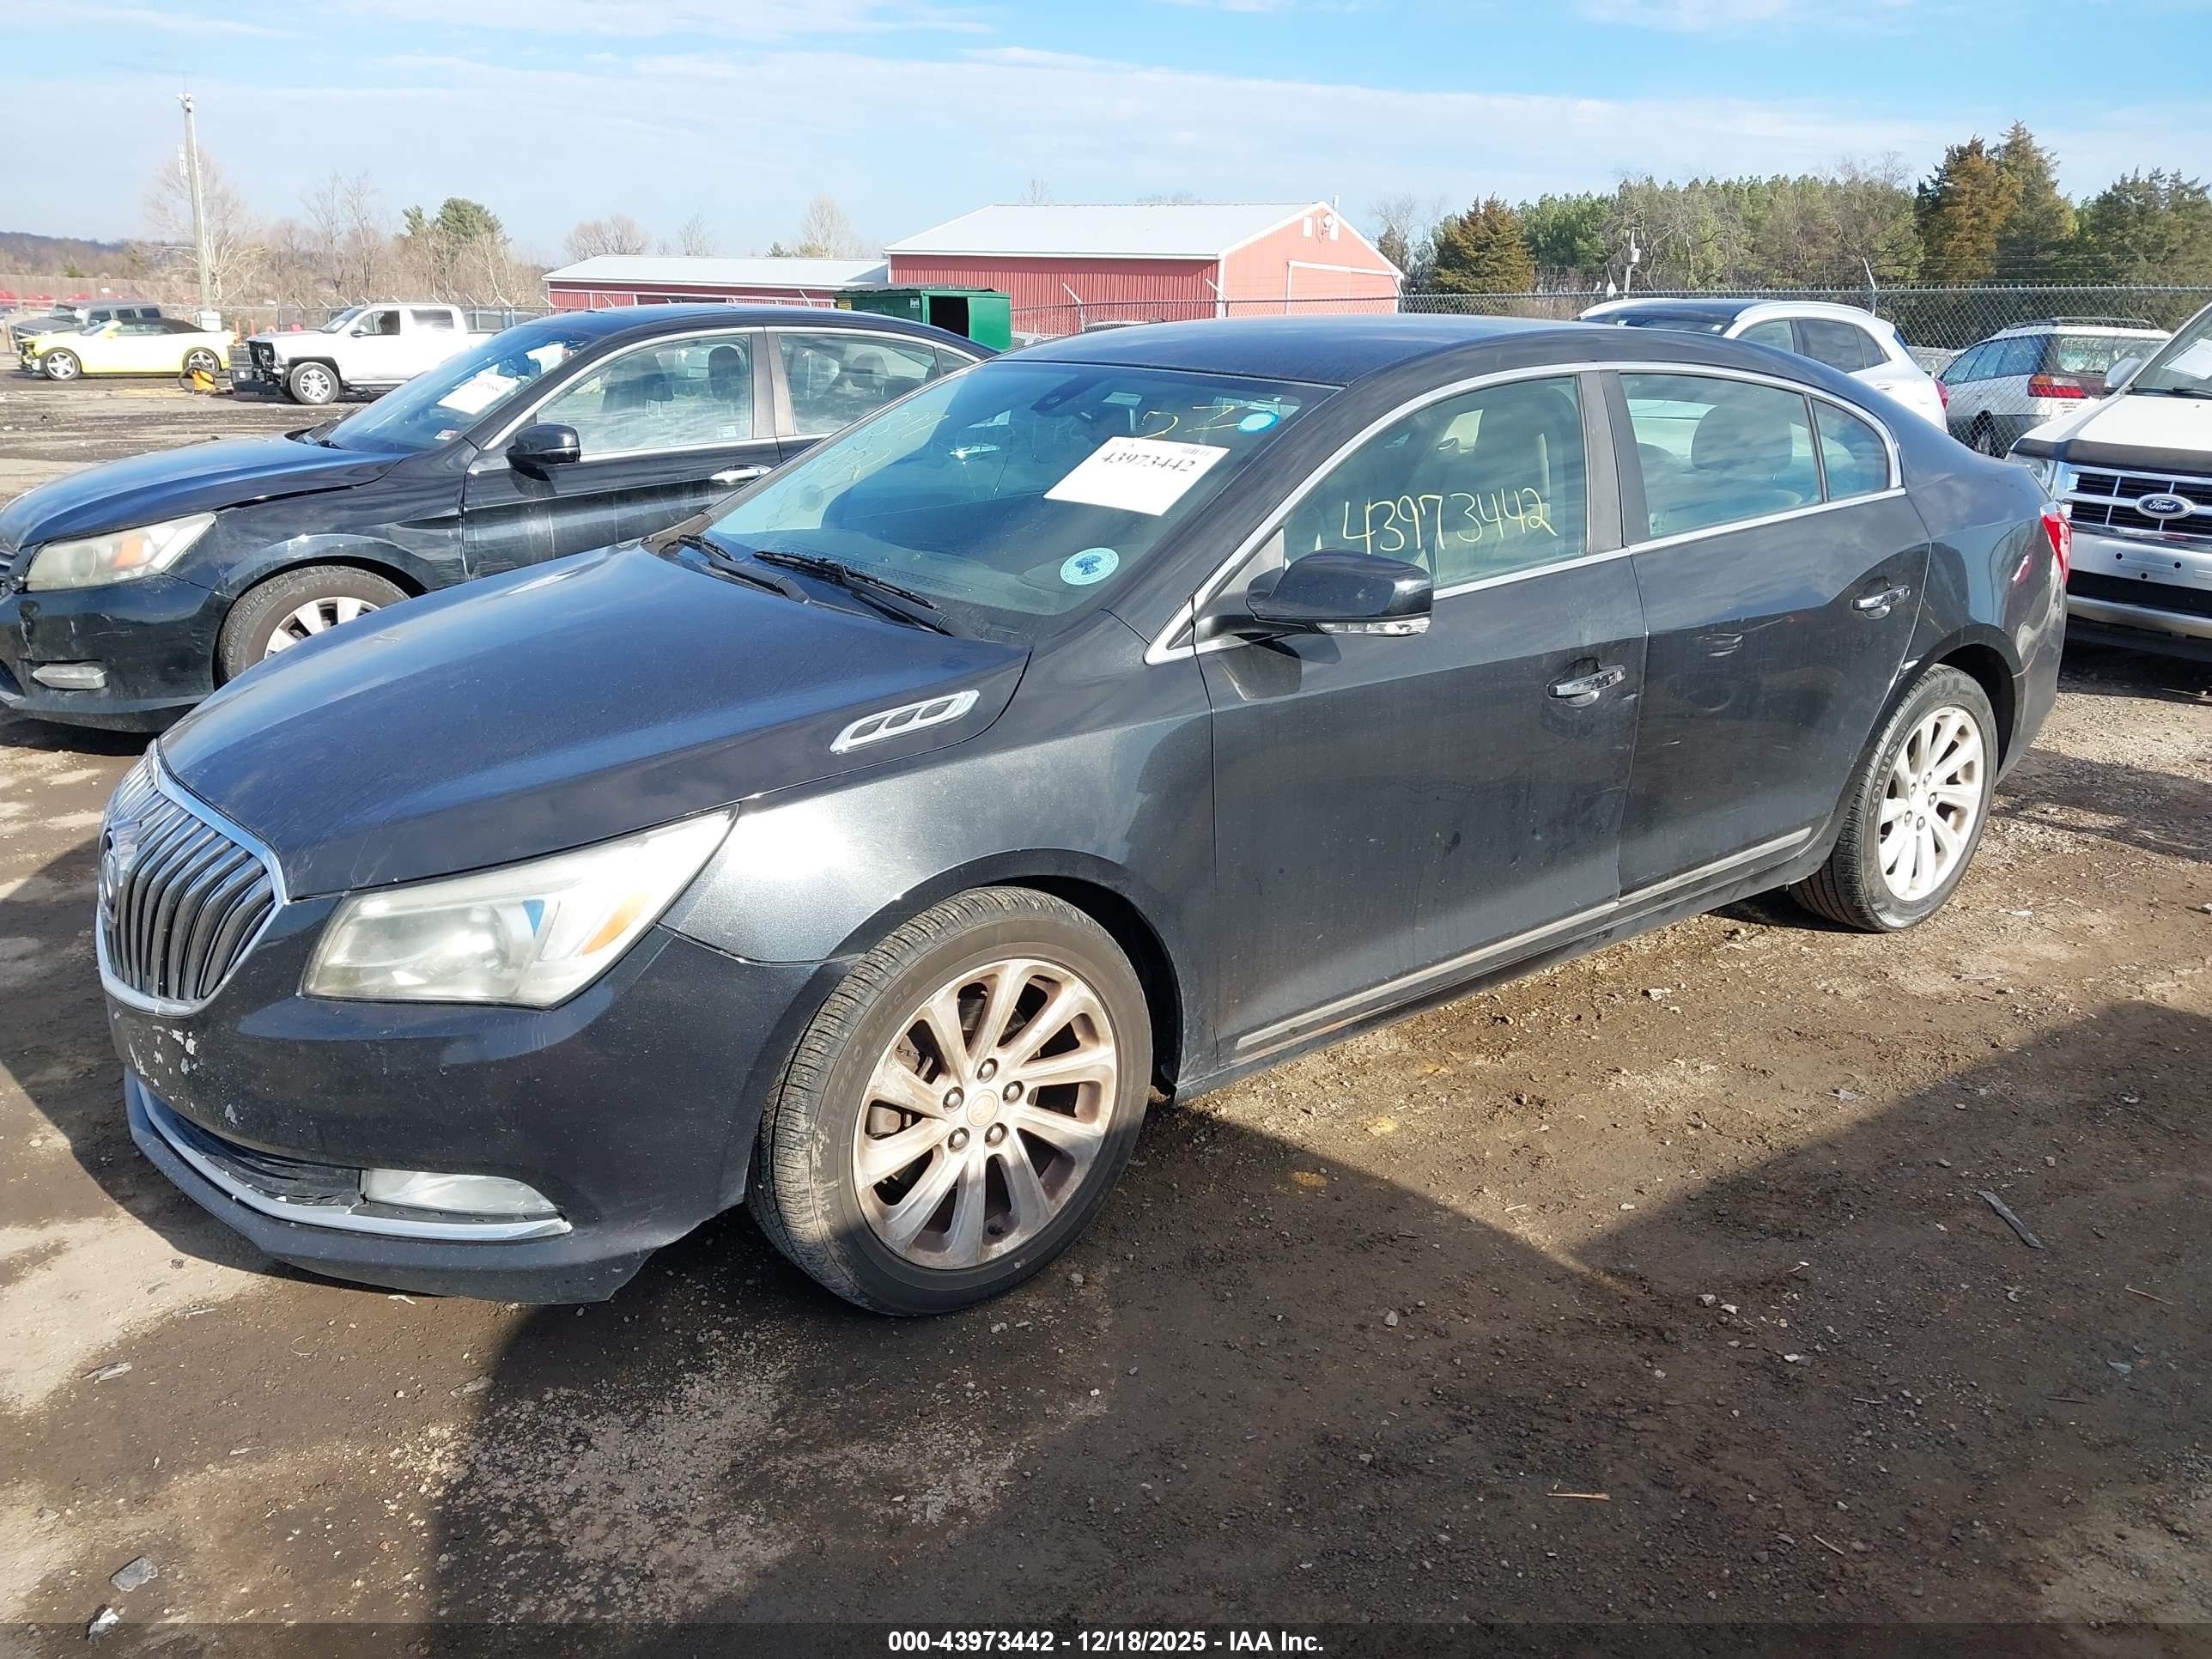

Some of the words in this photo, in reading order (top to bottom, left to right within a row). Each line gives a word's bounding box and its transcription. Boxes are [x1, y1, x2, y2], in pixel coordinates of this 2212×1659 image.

[1102, 452, 1196, 471] 43973442
[2148, 499, 2177, 511] Ford
[1342, 487, 1559, 555] 43973442
